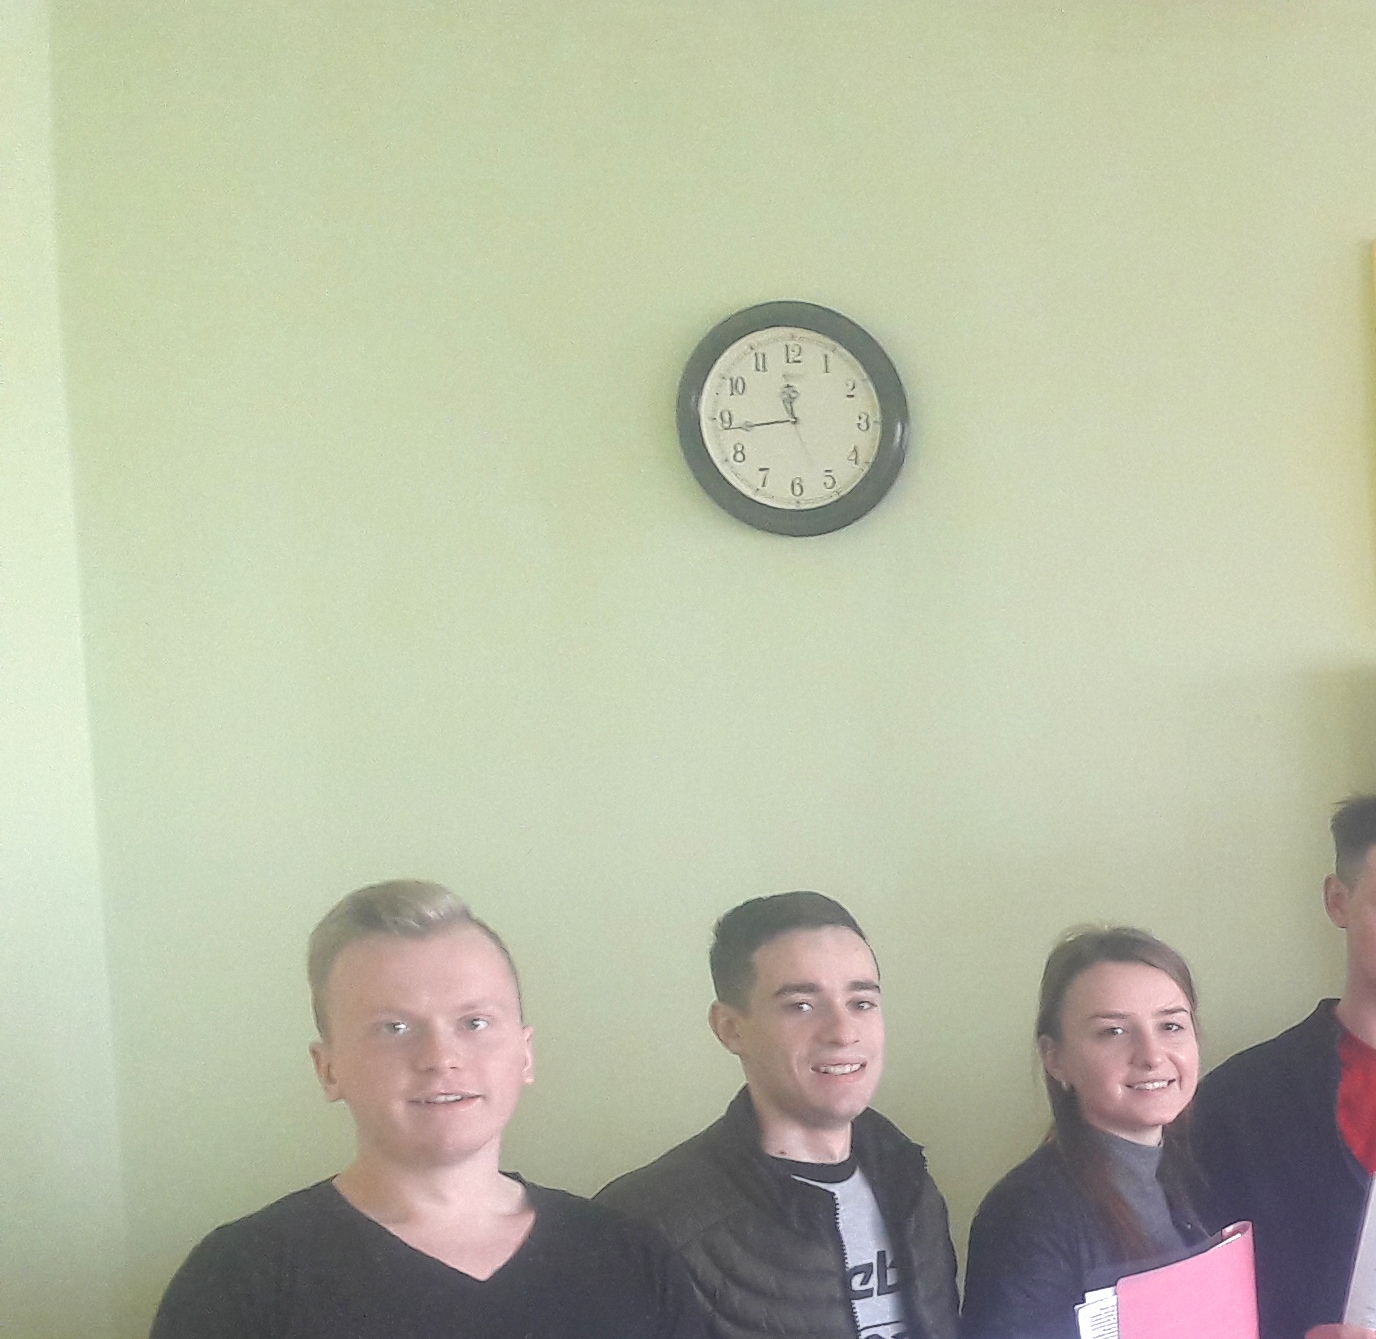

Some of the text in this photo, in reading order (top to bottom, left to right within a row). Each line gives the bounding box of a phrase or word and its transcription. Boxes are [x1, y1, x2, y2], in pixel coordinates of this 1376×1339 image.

[754, 352, 768, 372] 11
[784, 344, 803, 364] 12
[729, 375, 745, 396] 10
[845, 379, 856, 398] 2
[720, 408, 733, 430] 9
[857, 411, 869, 432] 3
[733, 442, 746, 463] 8
[847, 446, 858, 465] 4
[759, 467, 770, 488] 7
[791, 476, 804, 497] 6
[823, 469, 837, 490] 5
